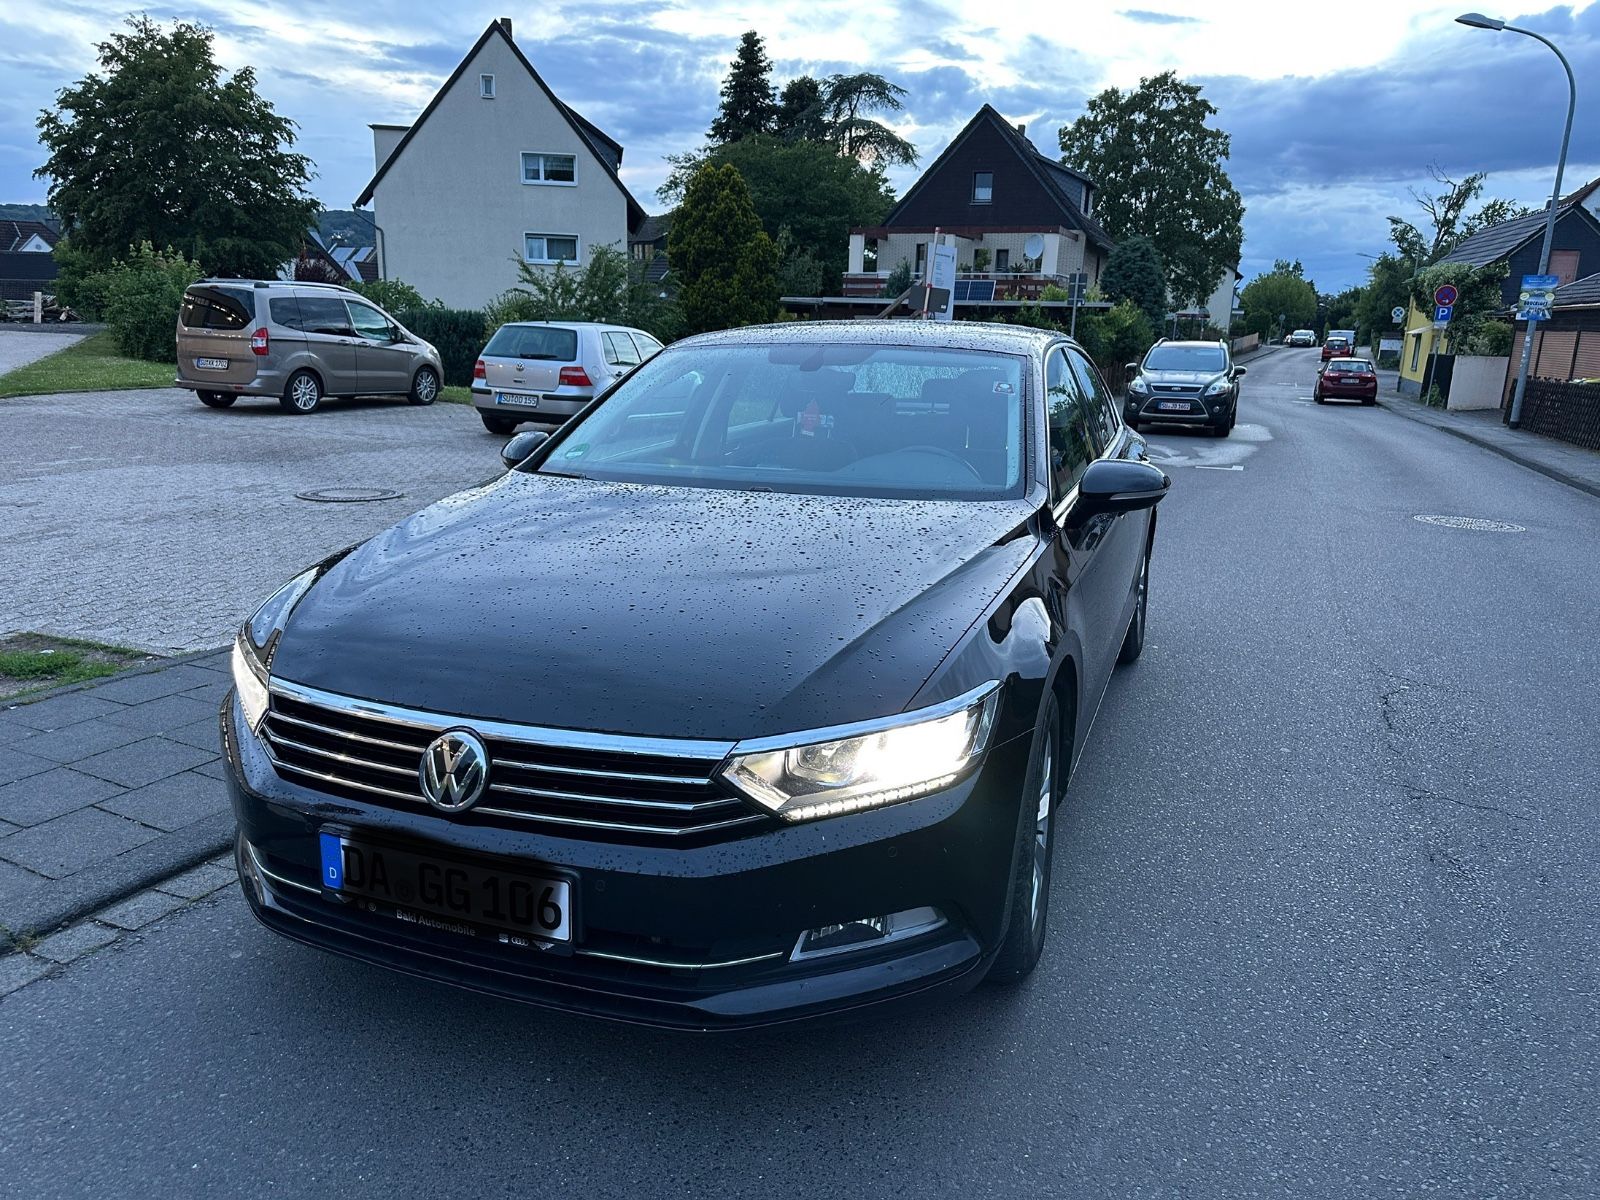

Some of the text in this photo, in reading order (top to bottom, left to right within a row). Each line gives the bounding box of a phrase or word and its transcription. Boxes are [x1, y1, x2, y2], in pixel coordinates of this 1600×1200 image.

[1438, 308, 1448, 320] P
[524, 396, 536, 405] 155
[329, 867, 337, 879] D
[342, 845, 562, 930] DA GG 106
[418, 915, 477, 937] Automobile
